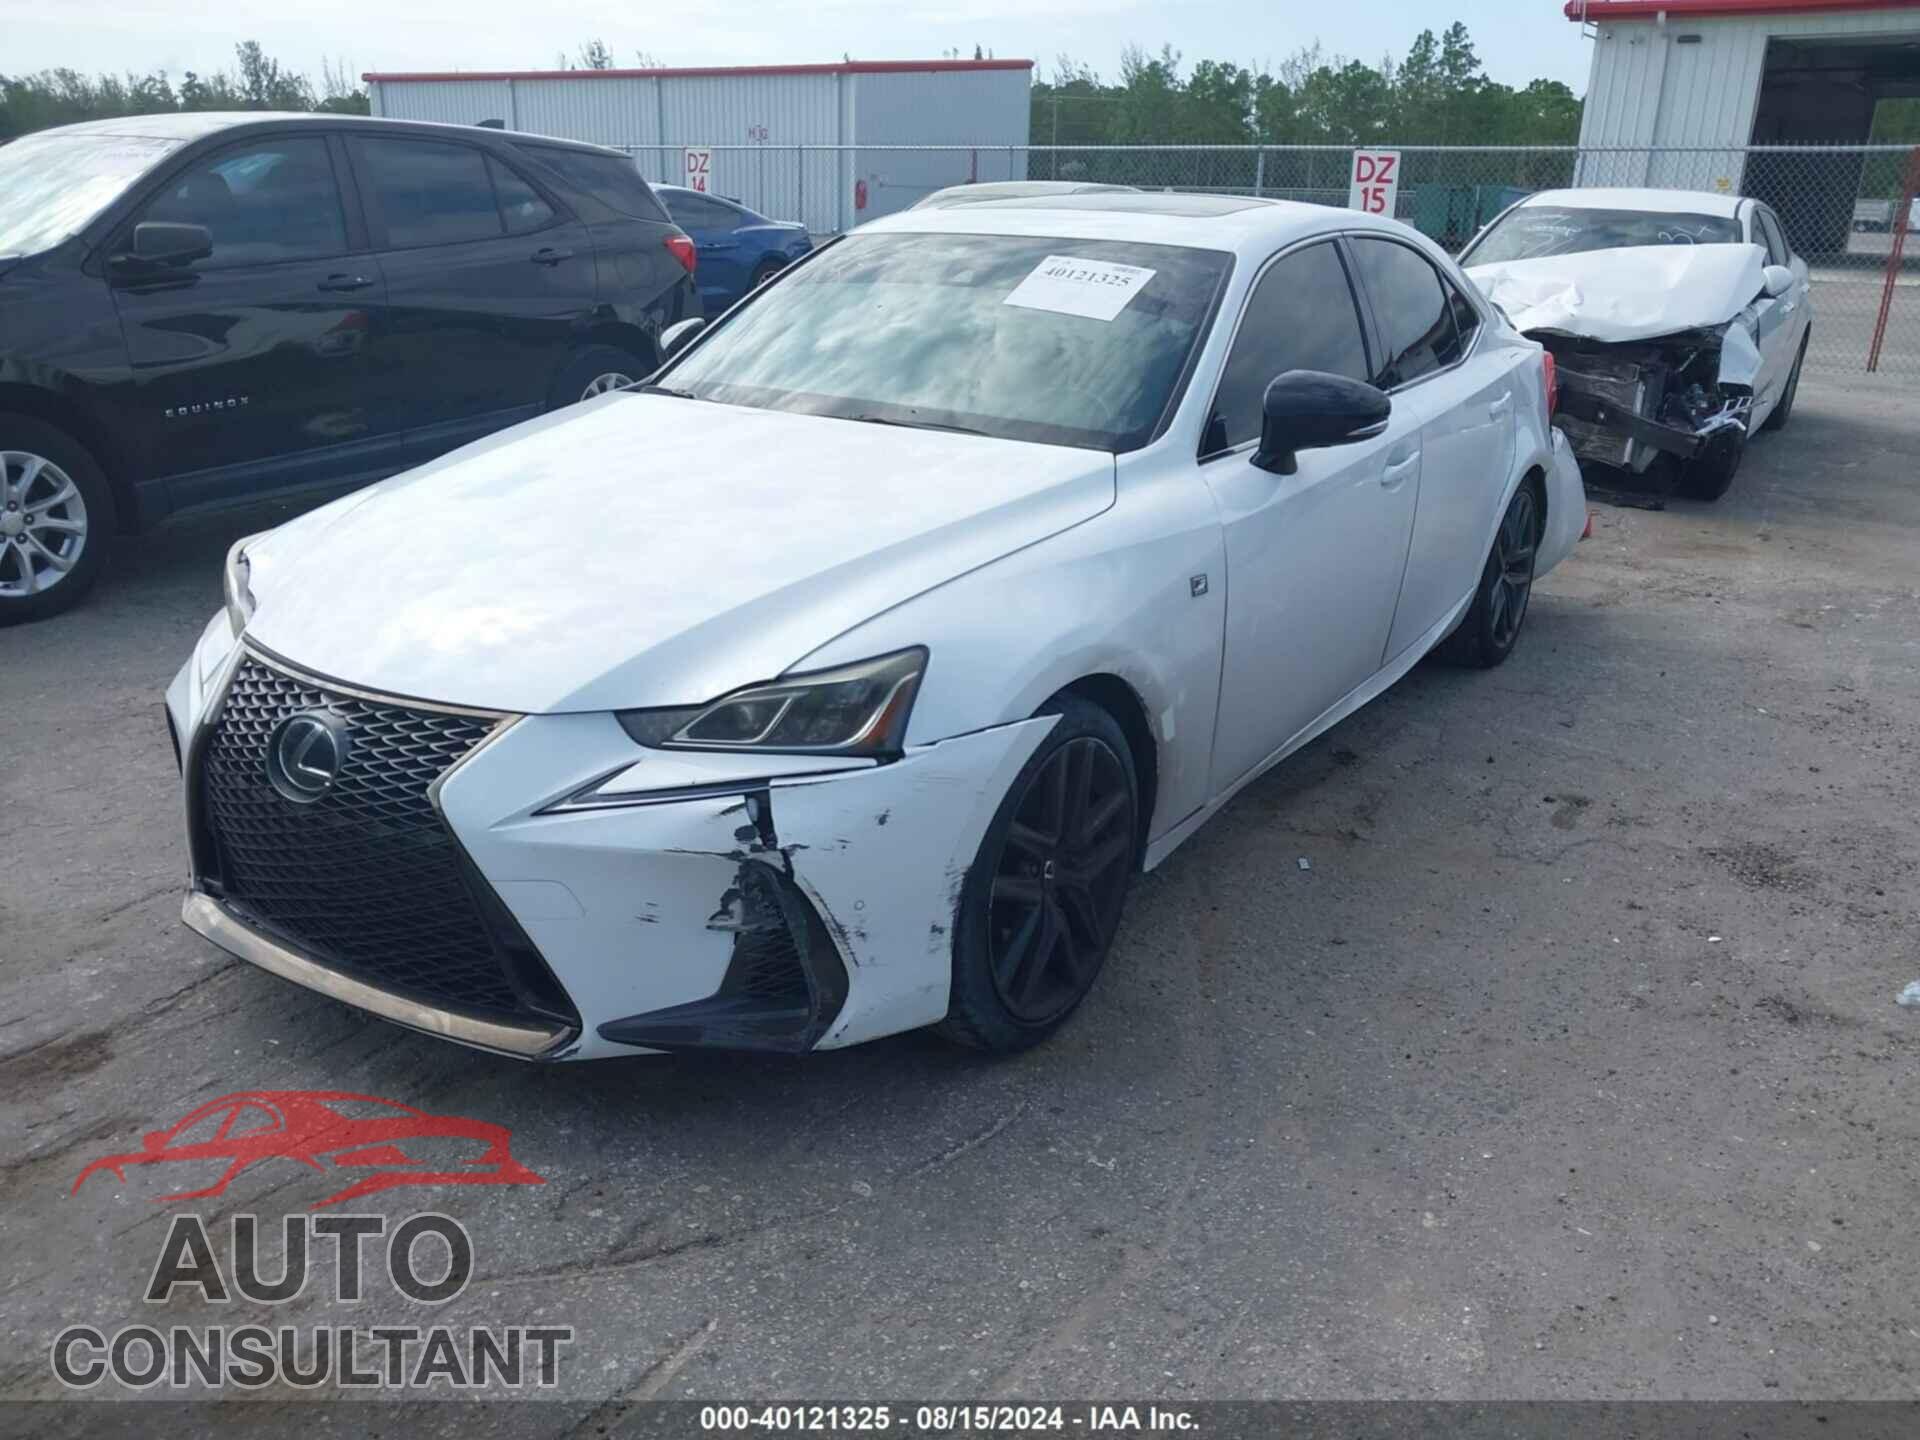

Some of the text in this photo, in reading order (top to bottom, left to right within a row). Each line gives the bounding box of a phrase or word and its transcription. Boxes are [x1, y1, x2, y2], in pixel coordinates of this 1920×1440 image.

[687, 152, 709, 173] DZ
[1356, 155, 1396, 184] DZ
[692, 175, 705, 192] 14
[1361, 187, 1386, 214] 15
[1045, 265, 1132, 287] 40121325
[164, 395, 249, 418] EQUINOX
